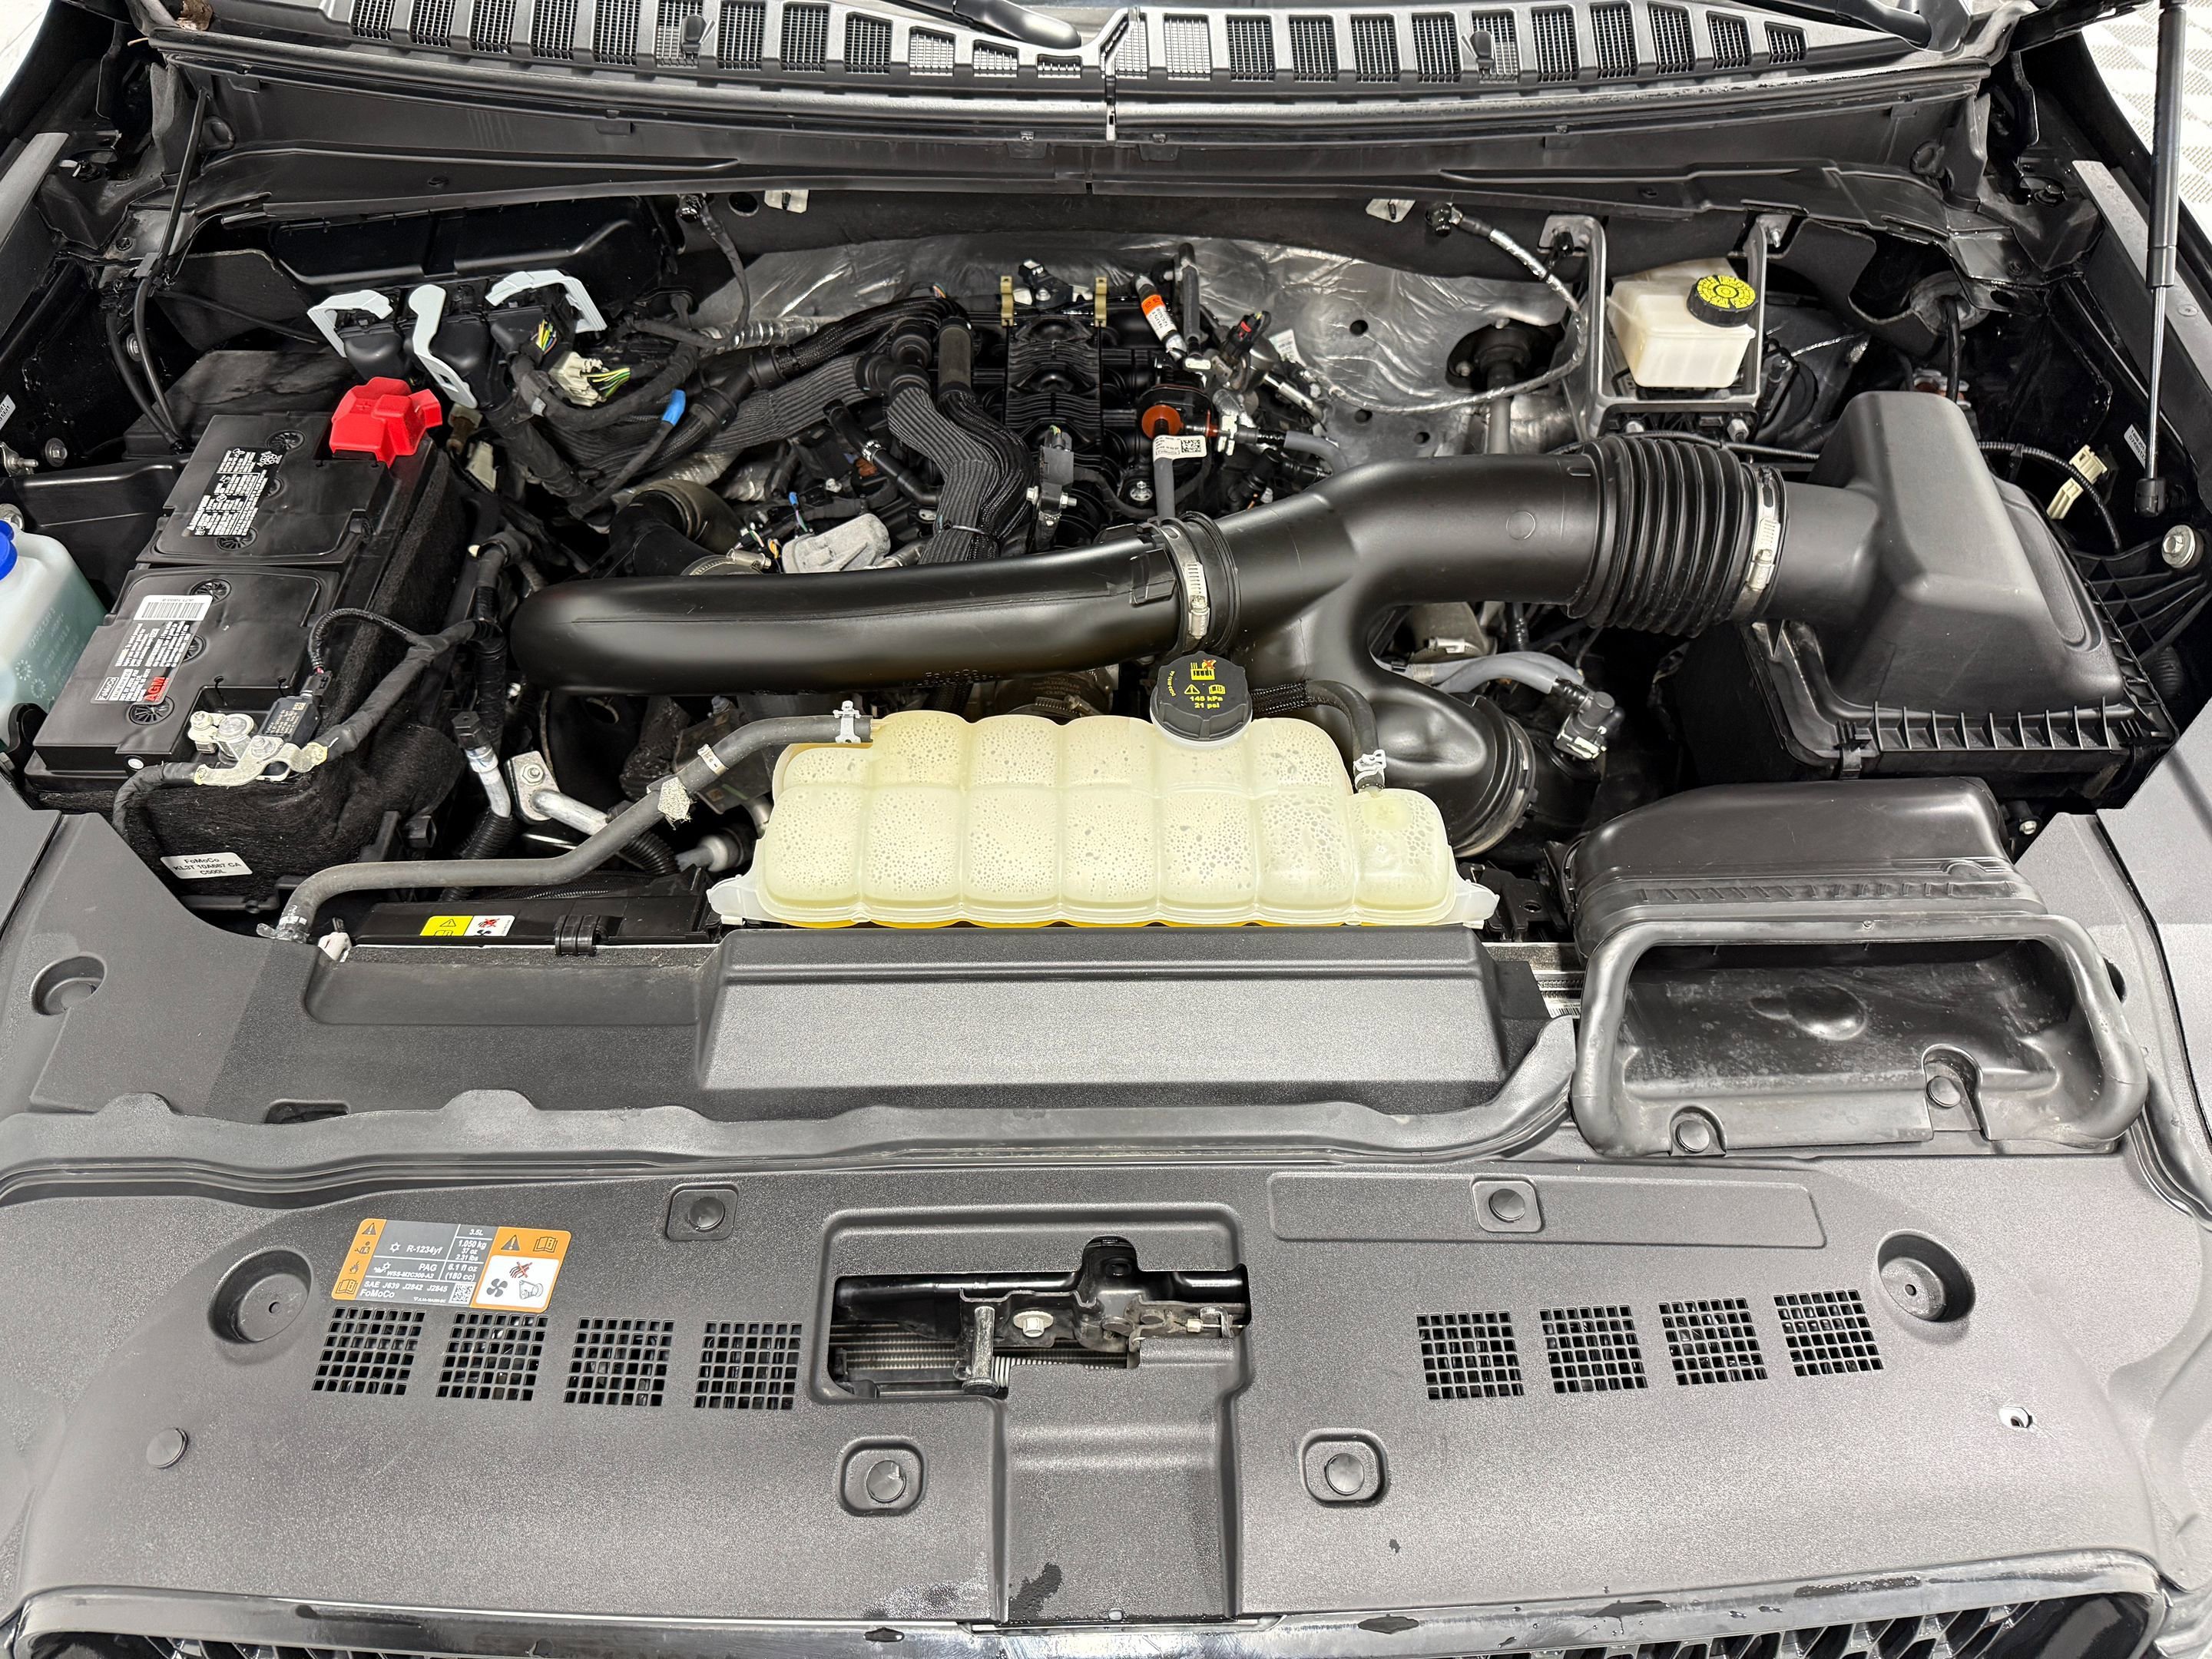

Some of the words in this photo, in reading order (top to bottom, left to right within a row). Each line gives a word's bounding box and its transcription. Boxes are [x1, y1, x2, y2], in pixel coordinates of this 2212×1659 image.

[98, 677, 118, 700] FoMoCo
[144, 677, 166, 701] AGM
[458, 1240, 477, 1248] 1.050
[477, 1240, 487, 1250] kg
[406, 1245, 443, 1256] R-1234yf
[418, 1263, 438, 1272] PAG
[462, 1273, 475, 1282] cc)
[359, 1288, 395, 1298] FoMoCo
[402, 1283, 423, 1292] J2842
[426, 1284, 449, 1293] J2845
